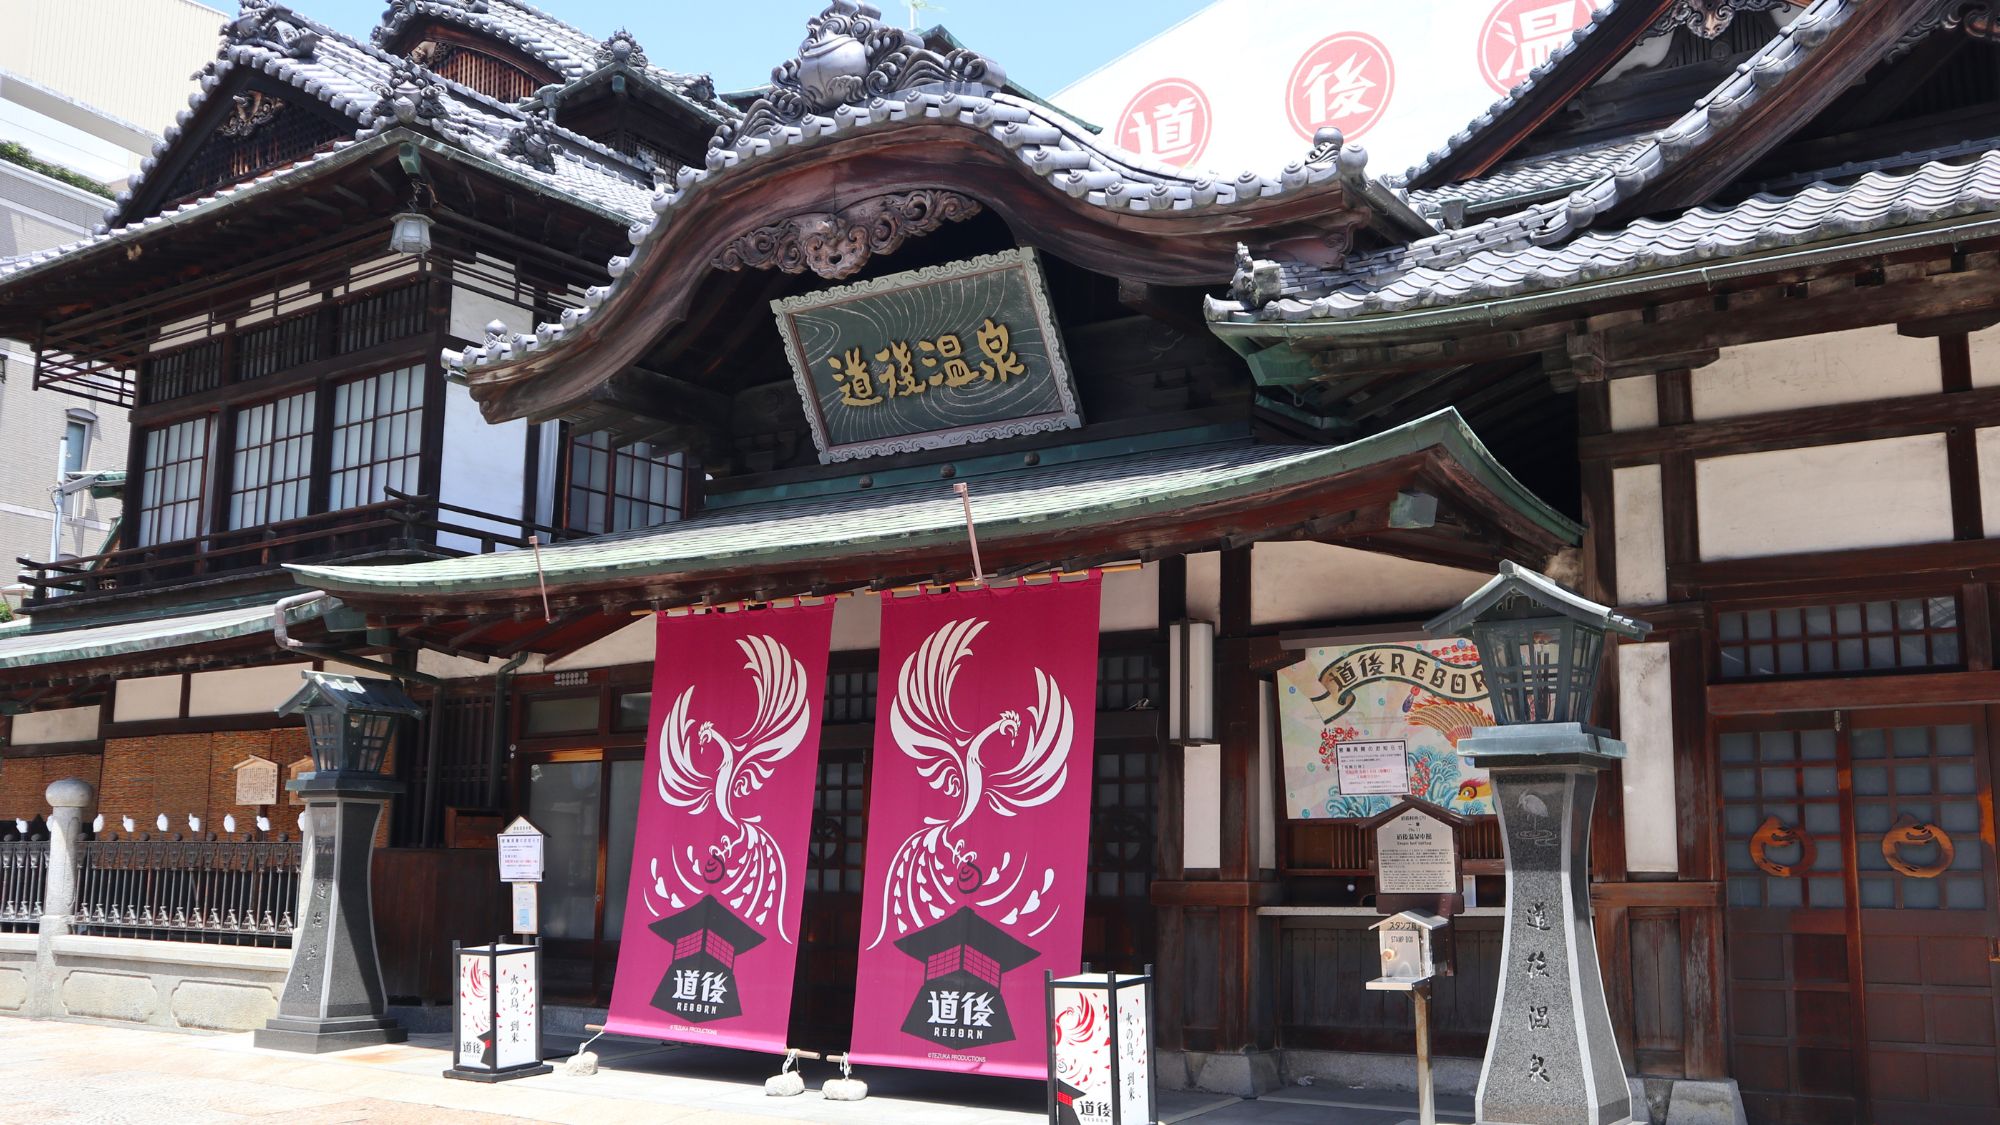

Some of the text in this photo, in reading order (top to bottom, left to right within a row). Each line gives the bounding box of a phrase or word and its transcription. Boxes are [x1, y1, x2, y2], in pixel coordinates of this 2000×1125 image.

[827, 318, 1025, 407] 道後温泉
[1330, 651, 1488, 694] 道後 REBOR
[672, 969, 728, 1004] 道後
[676, 1001, 717, 1015] REBORN
[927, 990, 995, 1027] 道後
[934, 1026, 983, 1039] REBORN
[463, 1041, 481, 1054] 道後
[1079, 1100, 1112, 1117] 道後
